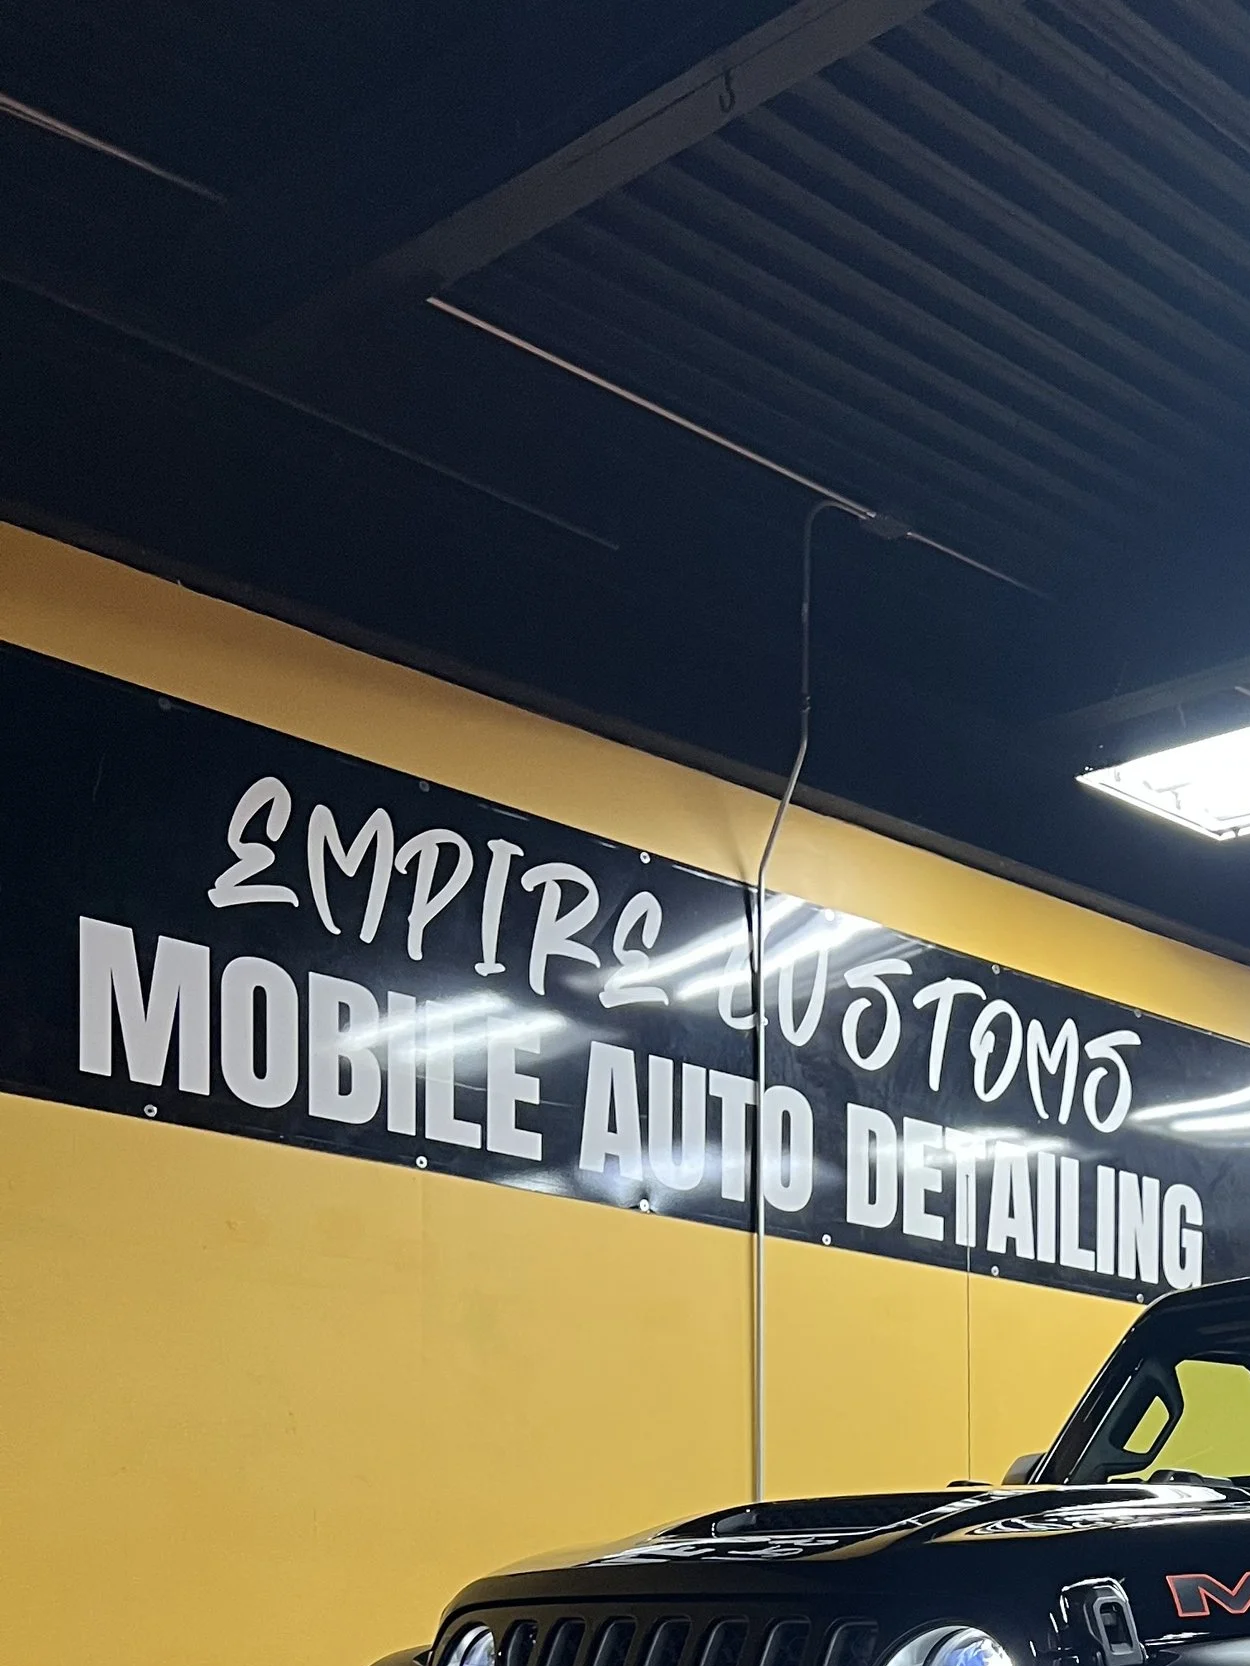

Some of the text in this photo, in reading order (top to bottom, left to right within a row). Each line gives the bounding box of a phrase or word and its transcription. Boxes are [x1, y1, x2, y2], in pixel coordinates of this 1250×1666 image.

[79, 915, 1204, 1290] MOBILE AUTO DETAILING
[207, 776, 1142, 1133] EMPIRE CUSTOMS
